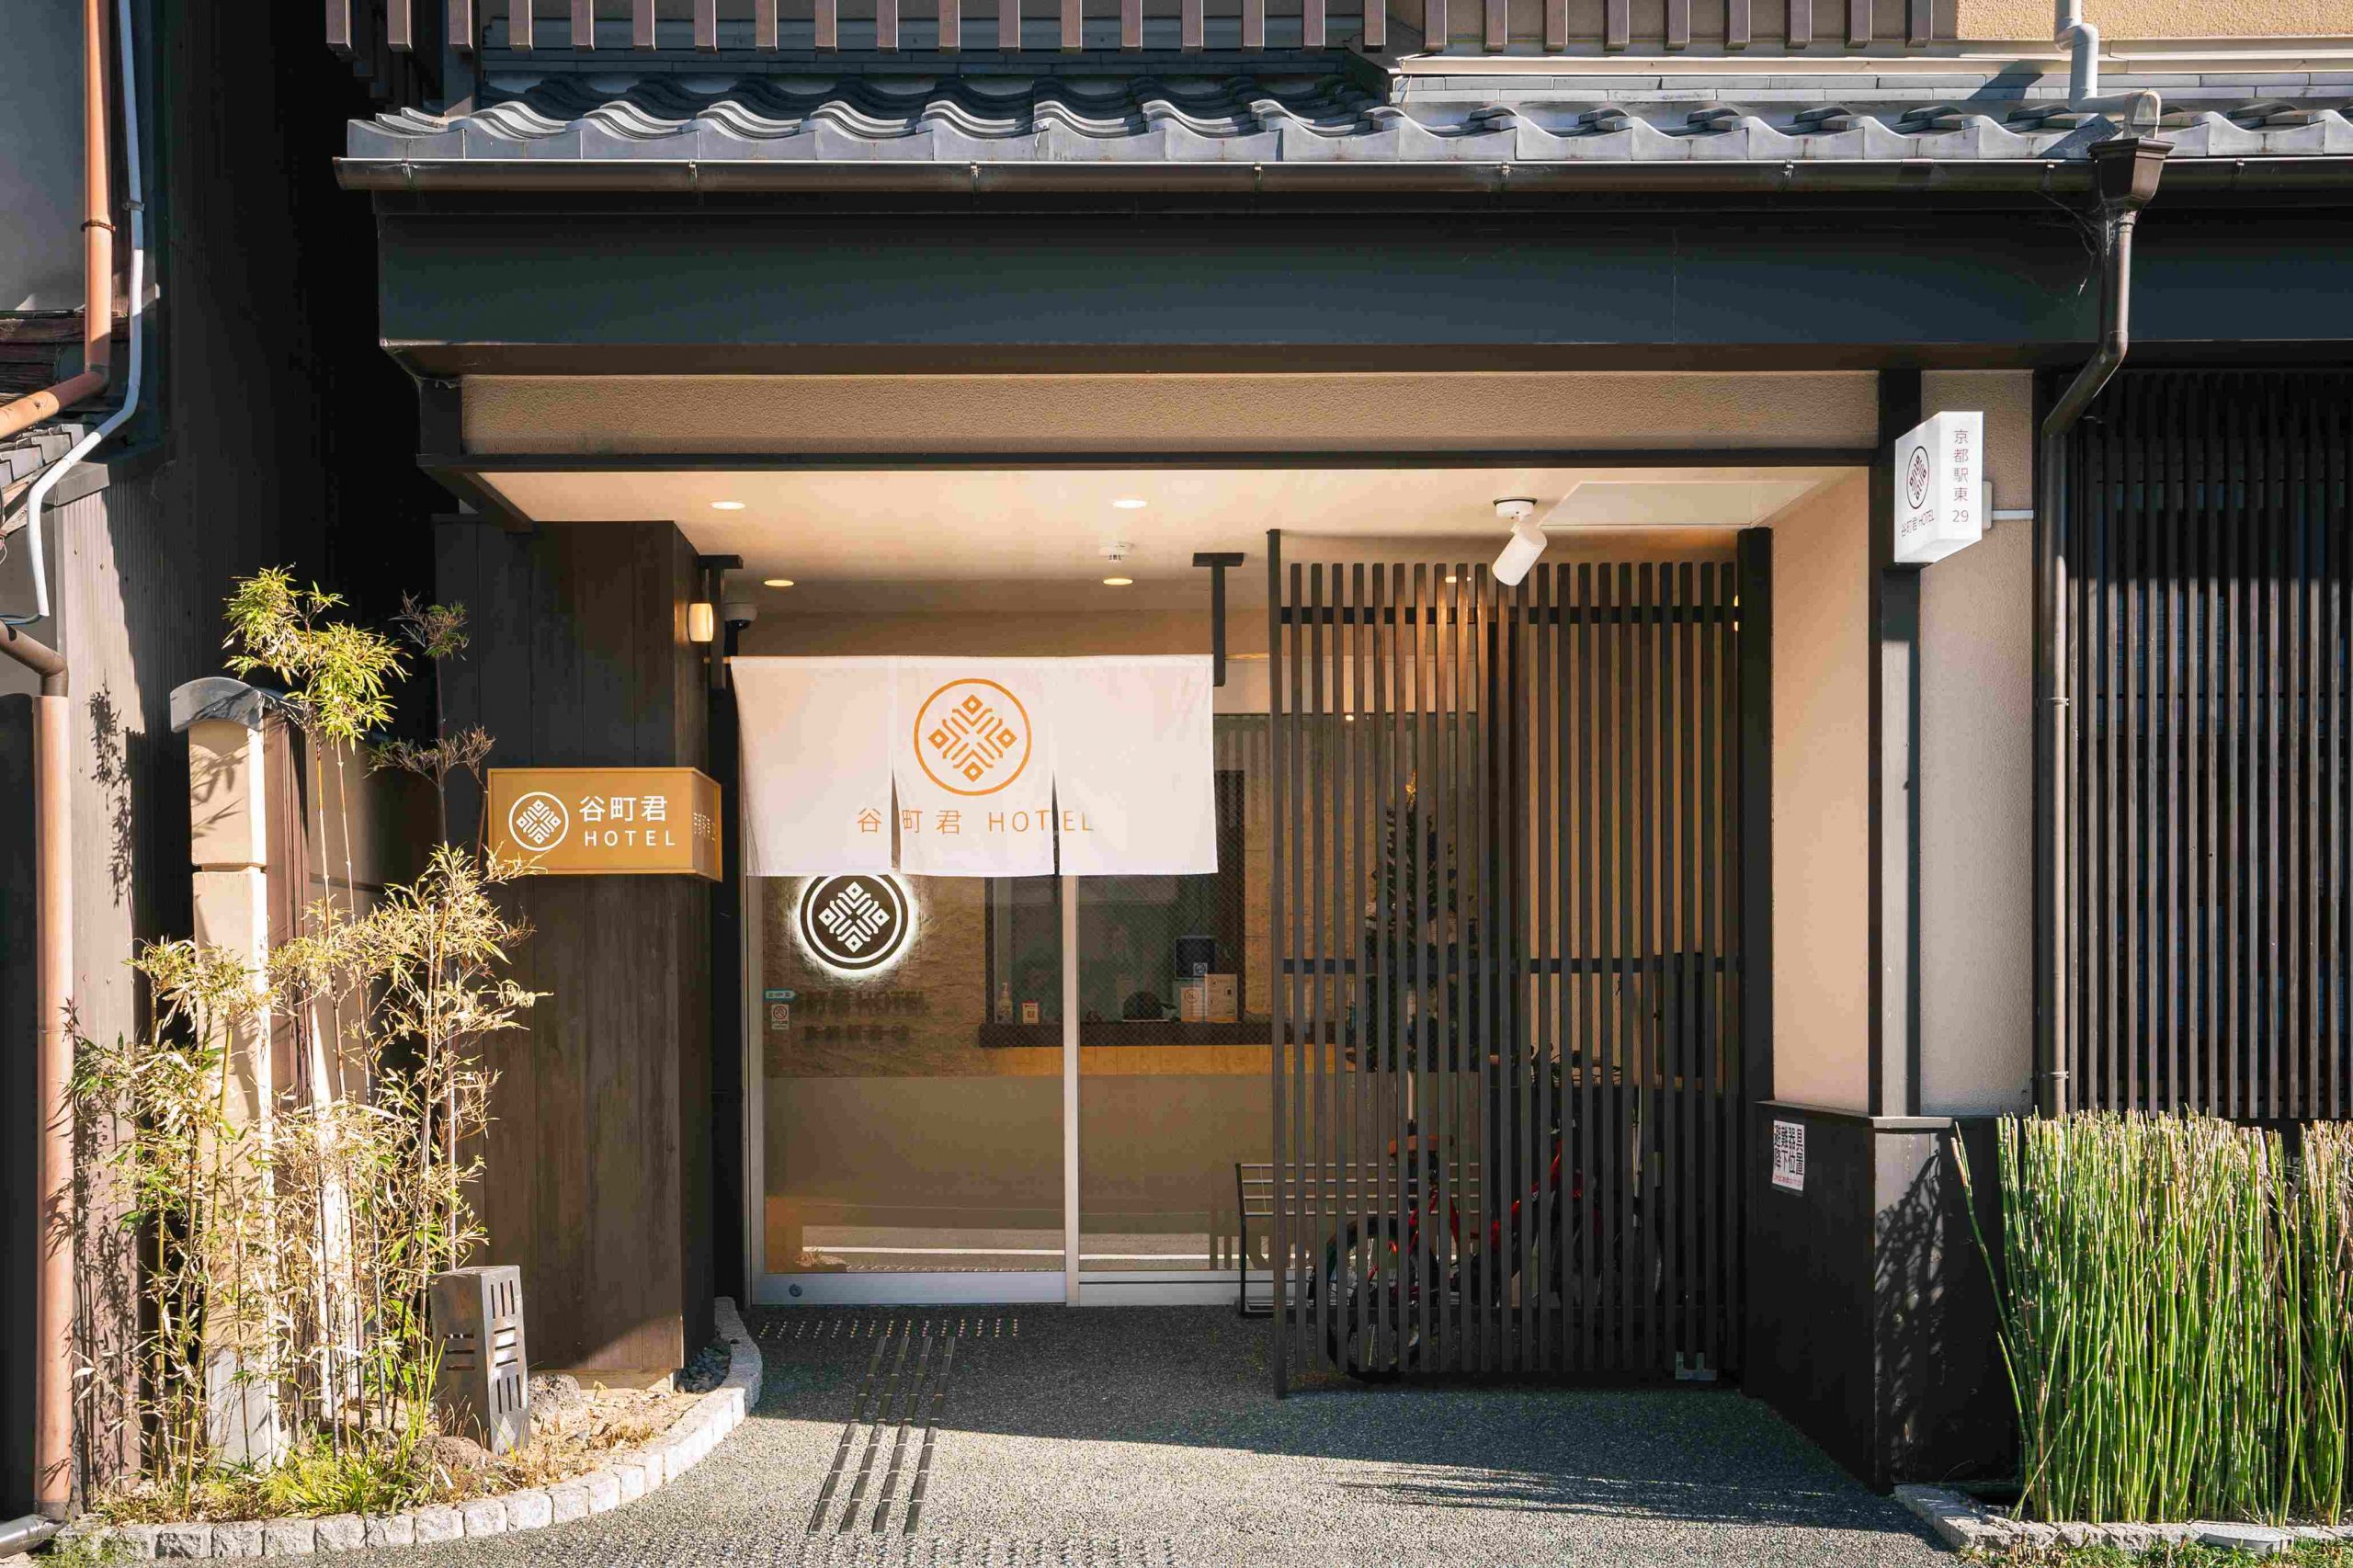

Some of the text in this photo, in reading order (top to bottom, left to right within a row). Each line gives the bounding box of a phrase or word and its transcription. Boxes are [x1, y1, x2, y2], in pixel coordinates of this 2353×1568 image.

[579, 796, 667, 822] 谷町君
[857, 808, 1094, 835] 谷町君 HOTEL
[584, 830, 676, 846] HOTEL
